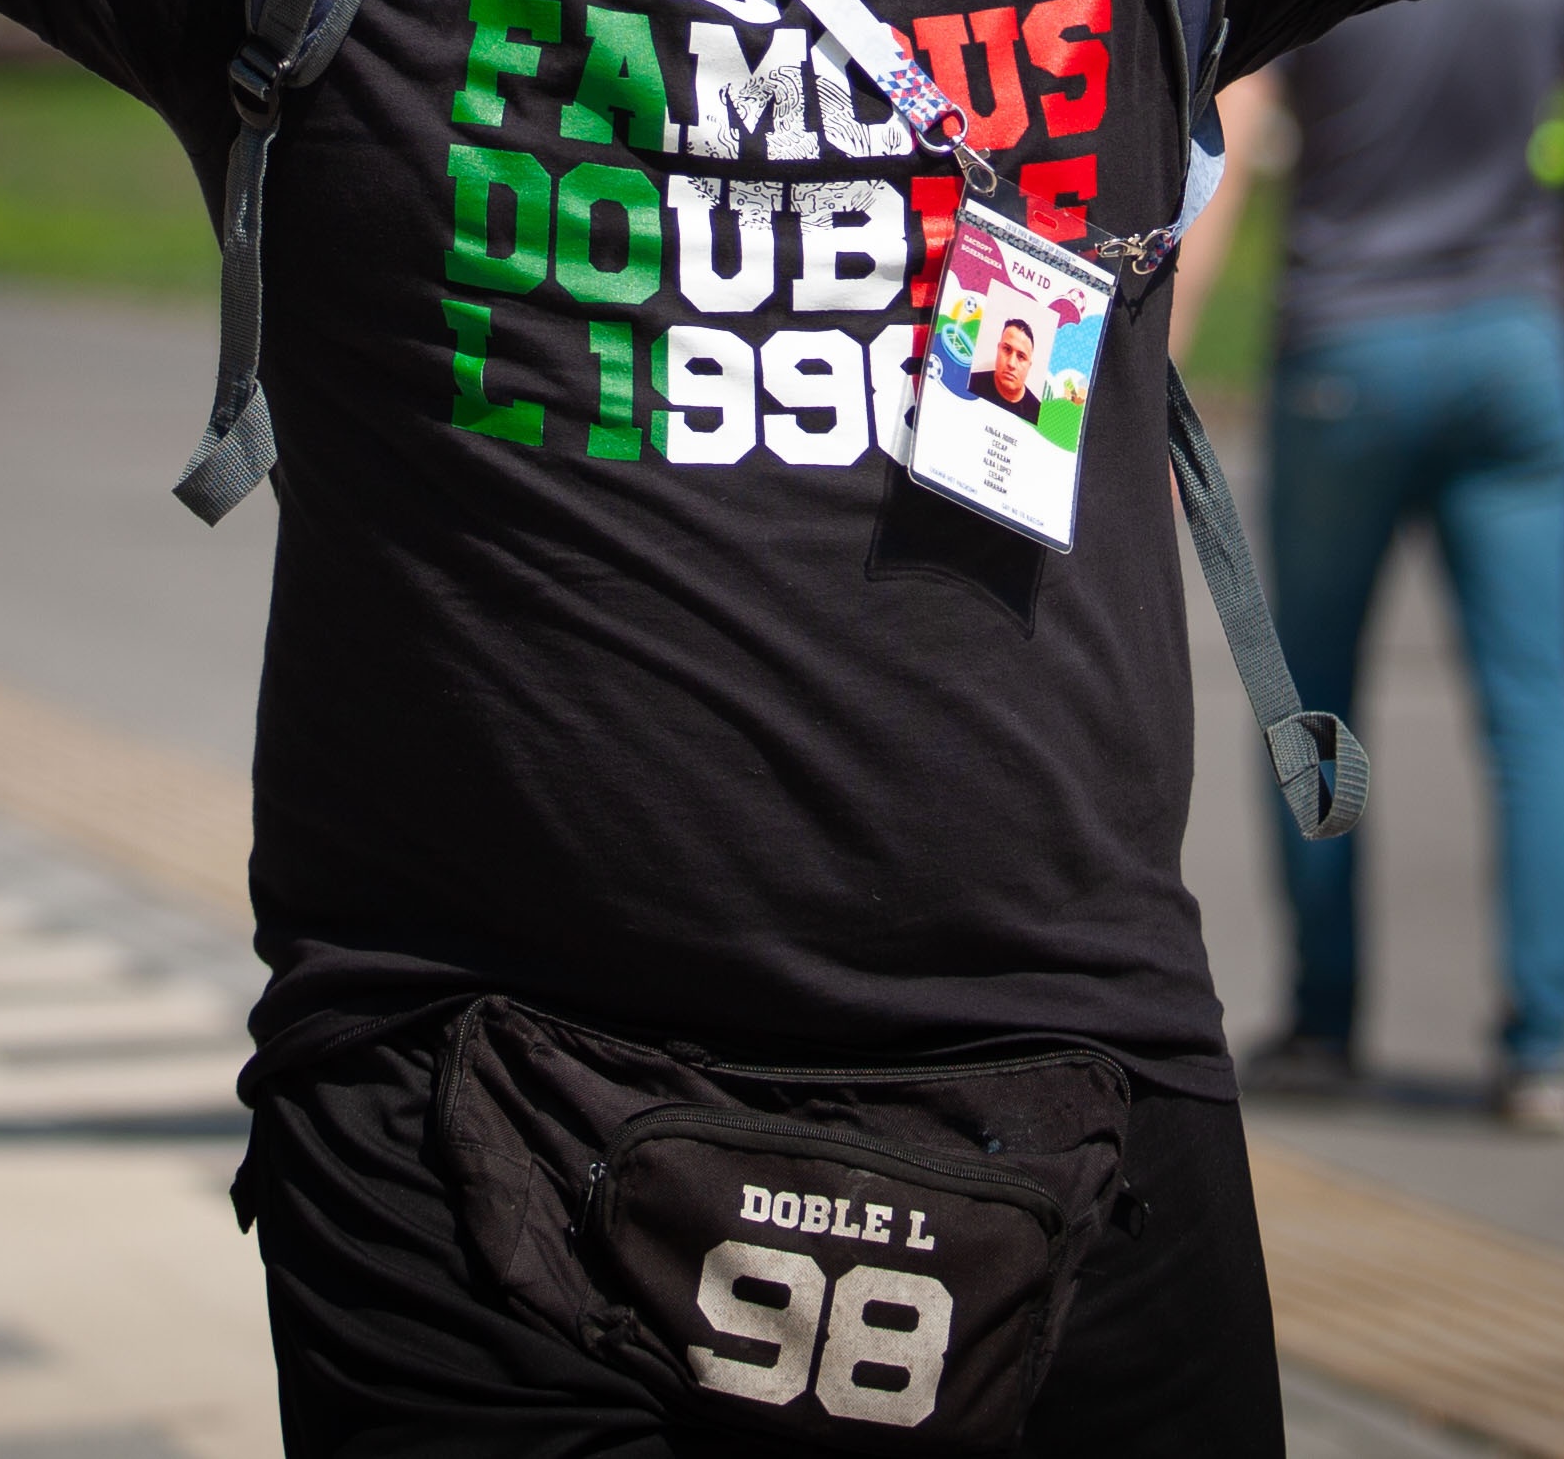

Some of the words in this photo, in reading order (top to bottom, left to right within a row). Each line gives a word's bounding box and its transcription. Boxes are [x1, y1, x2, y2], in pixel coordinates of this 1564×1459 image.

[1011, 259, 1033, 281] FAN
[1036, 273, 1051, 291] ID
[441, 299, 545, 448] L
[739, 1184, 893, 1244] DOBLE
[906, 1211, 934, 1251] L
[687, 1239, 954, 1428] 98
